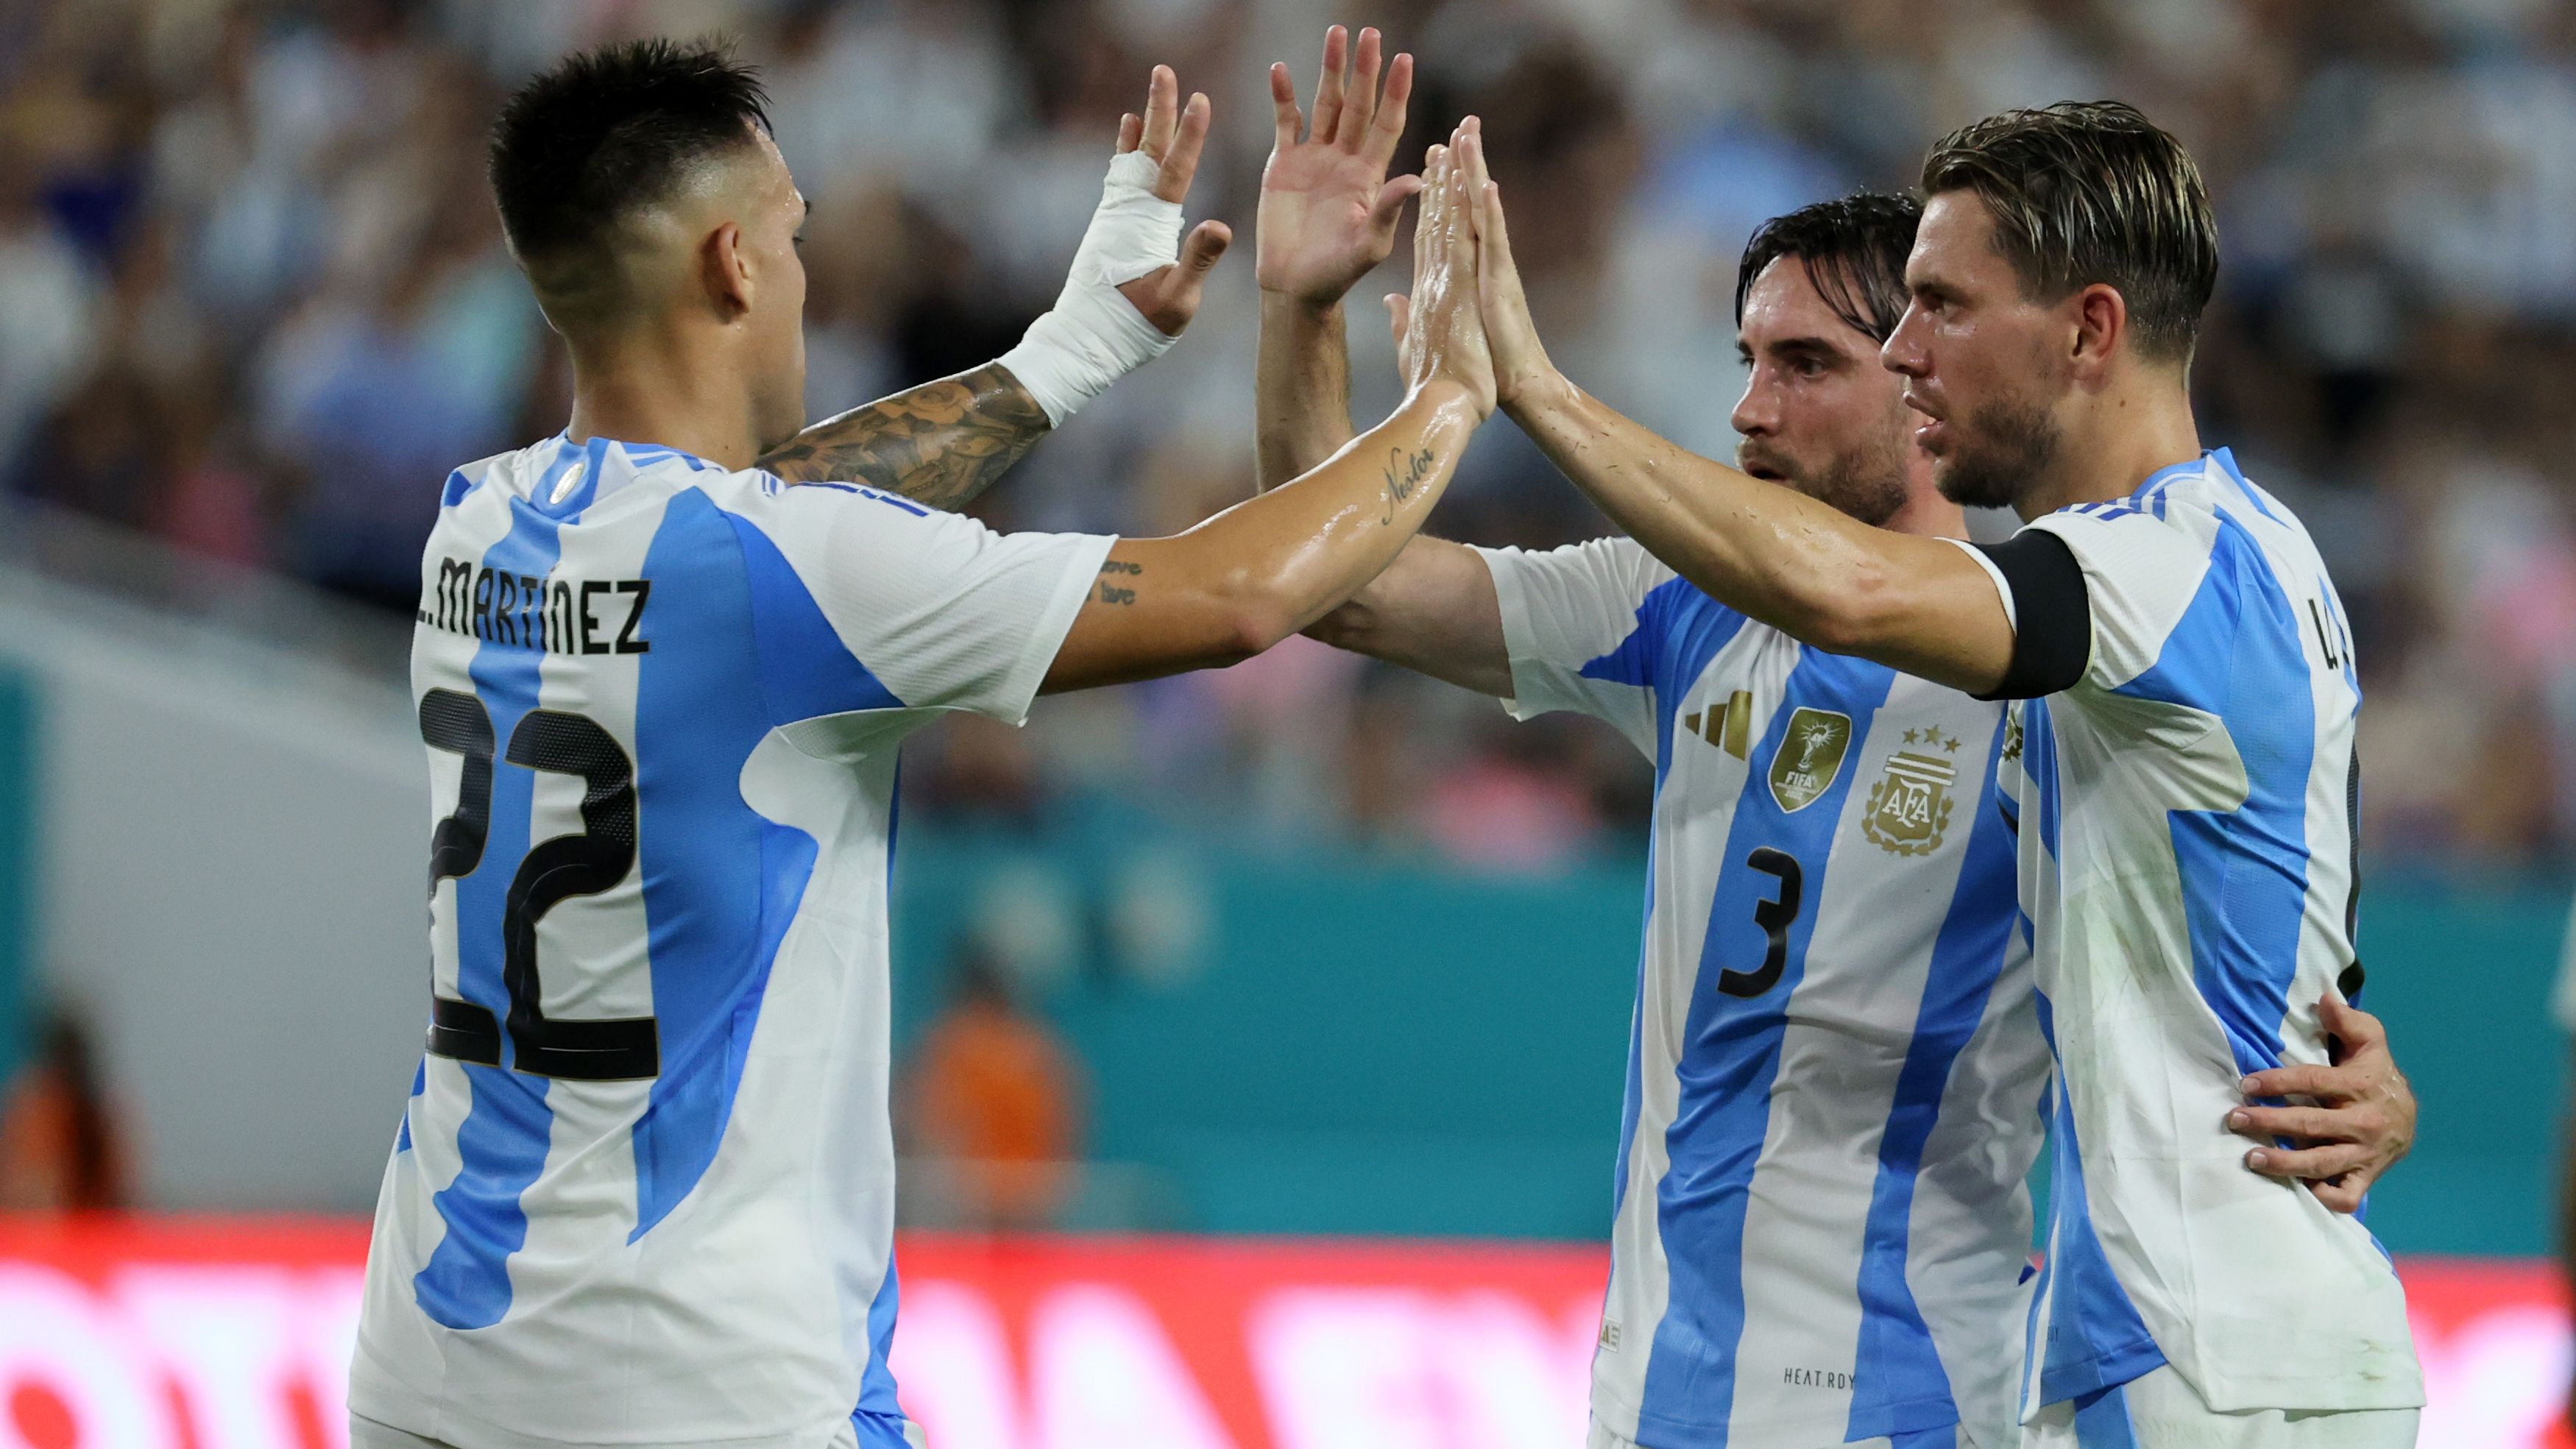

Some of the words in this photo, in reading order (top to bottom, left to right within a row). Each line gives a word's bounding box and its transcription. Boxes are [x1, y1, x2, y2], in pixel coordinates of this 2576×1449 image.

[1785, 771, 1814, 788] FIFA
[1882, 777, 1931, 828] AFA
[419, 687, 659, 1080] 22
[1717, 846, 1802, 999] 3
